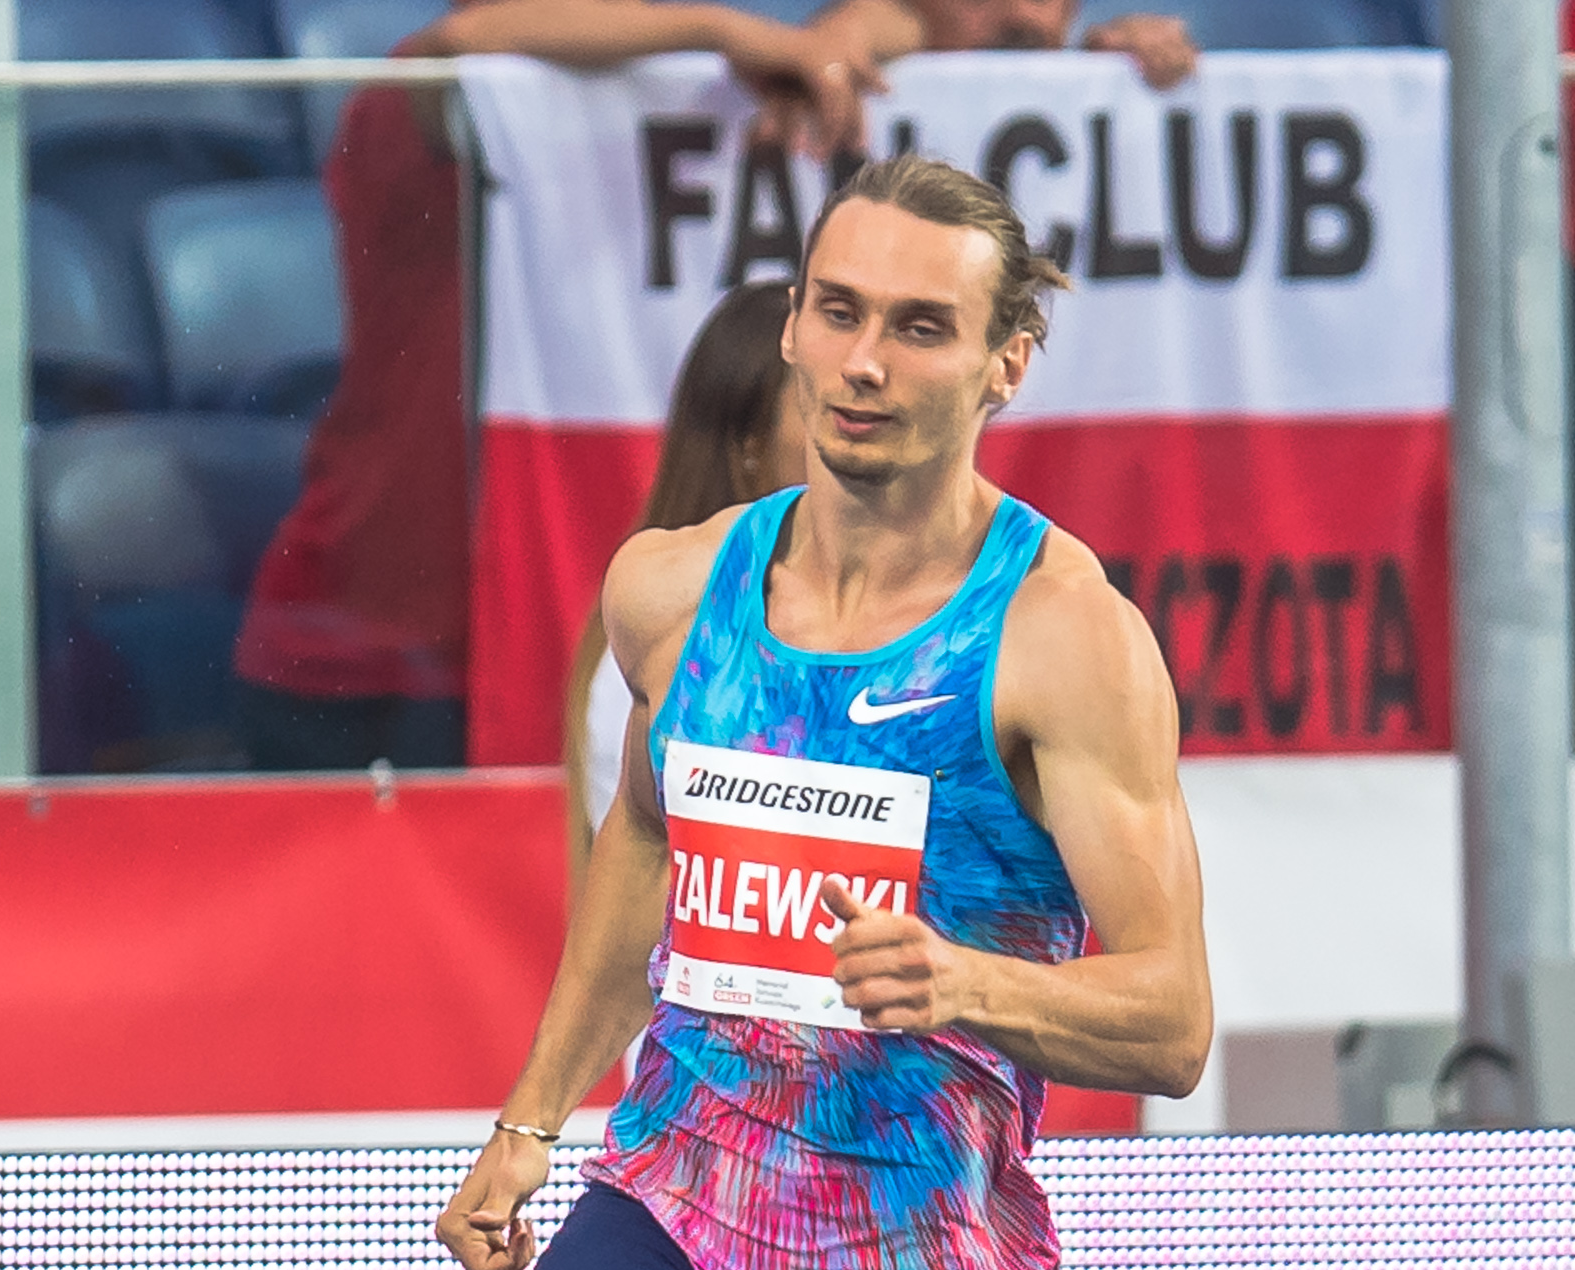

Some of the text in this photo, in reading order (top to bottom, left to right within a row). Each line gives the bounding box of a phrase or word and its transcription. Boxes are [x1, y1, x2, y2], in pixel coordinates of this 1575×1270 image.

[643, 108, 1377, 288] FA CLUB
[1103, 554, 1426, 738] CZOTA
[685, 768, 895, 822] BRIDGESTONE
